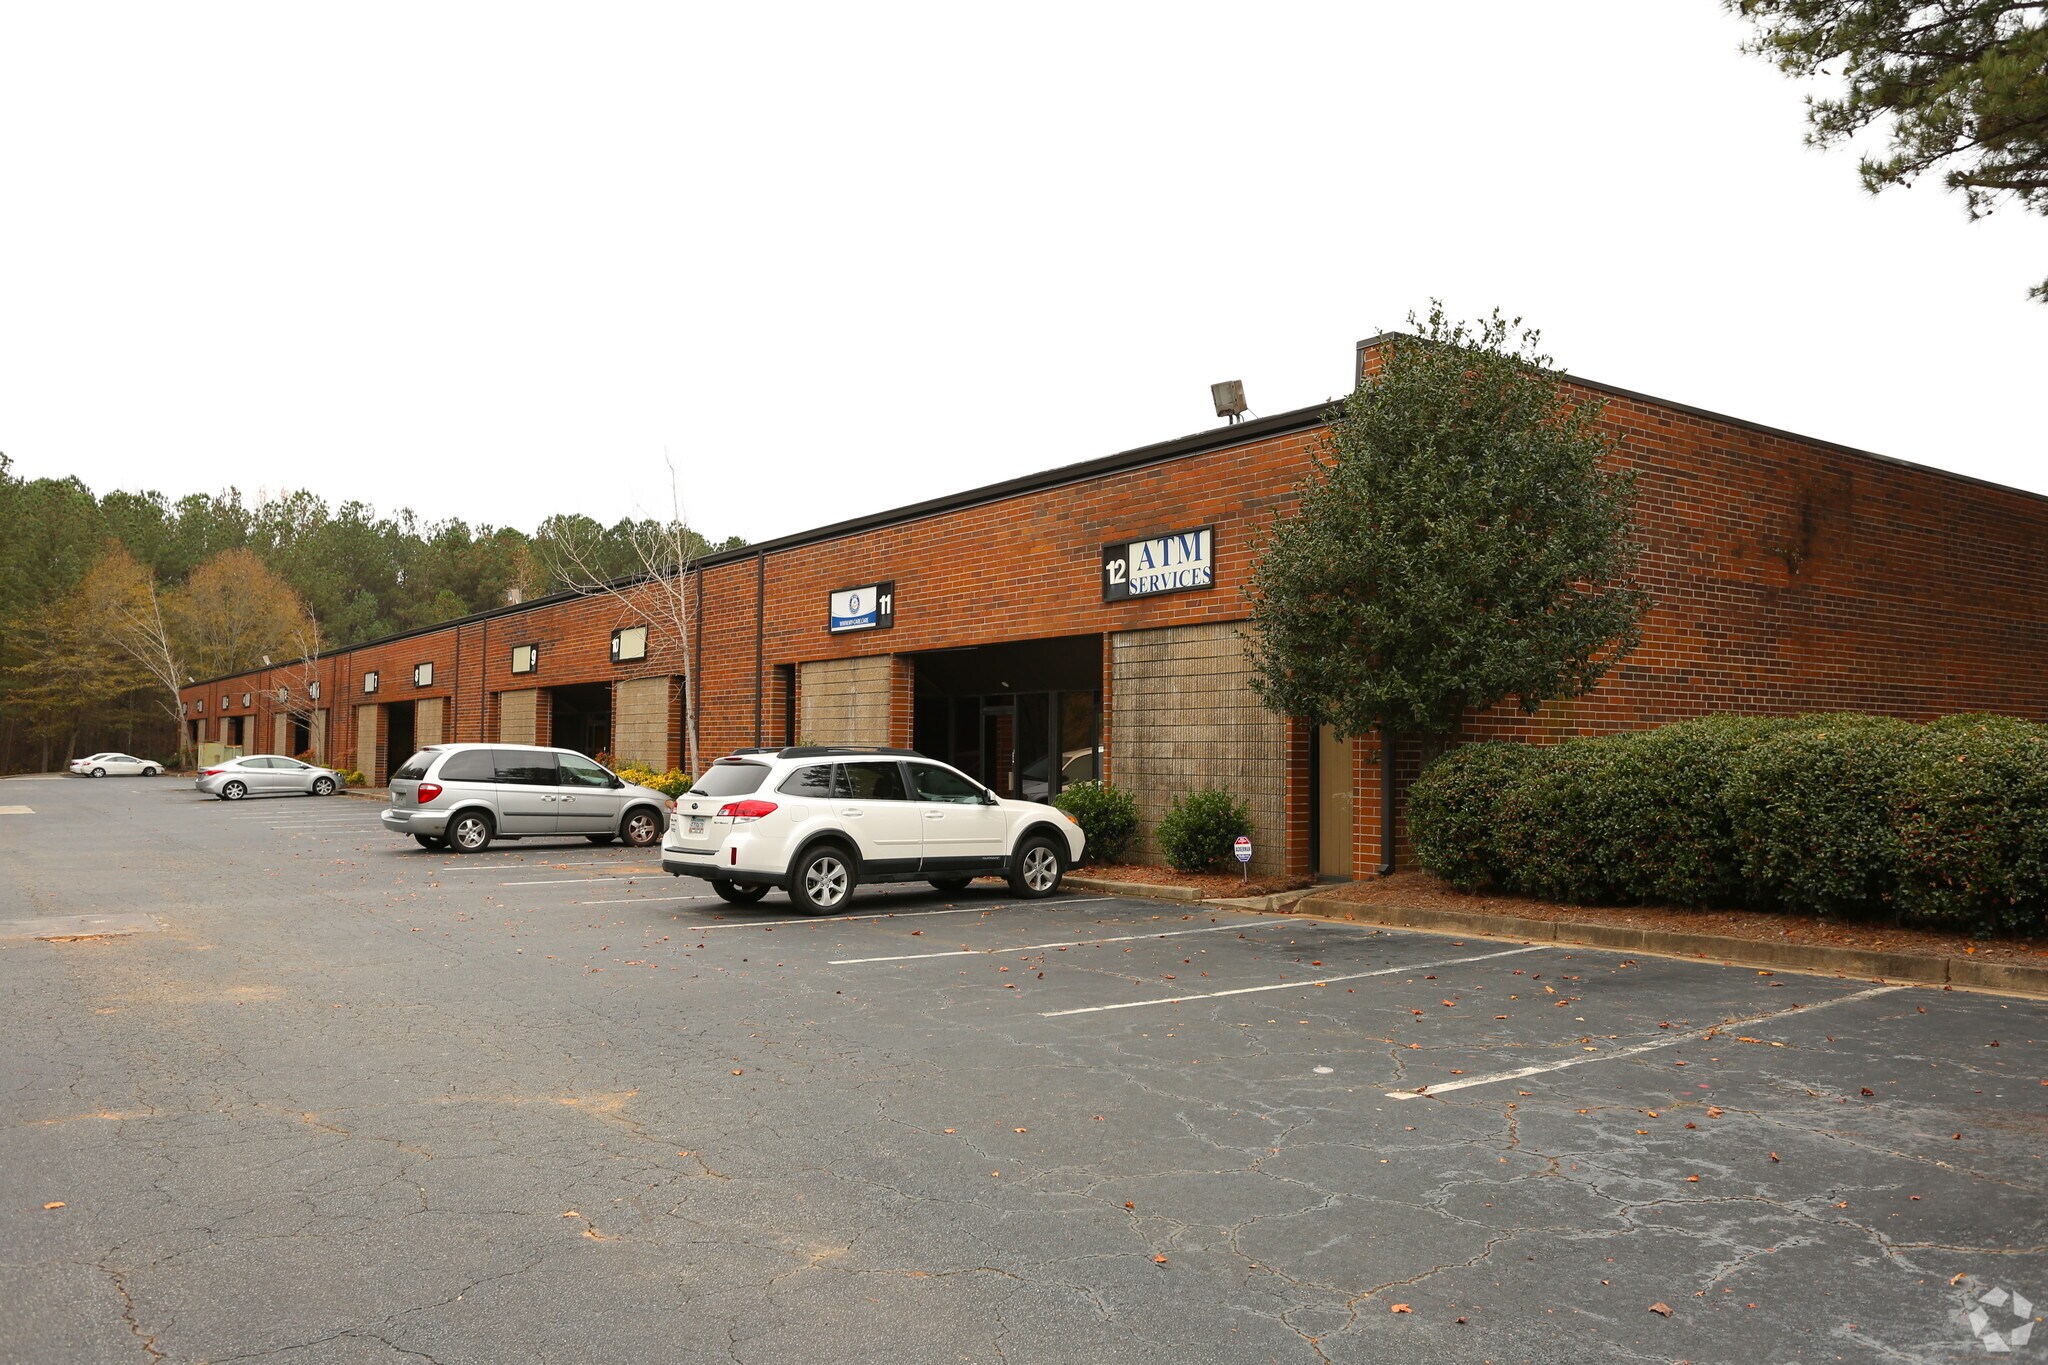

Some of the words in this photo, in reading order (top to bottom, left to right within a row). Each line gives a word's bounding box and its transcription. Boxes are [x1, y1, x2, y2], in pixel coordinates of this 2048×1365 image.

[1136, 530, 1203, 571] ATM
[1105, 558, 1126, 585] 12
[1129, 565, 1211, 596] SERVICES
[879, 594, 891, 615] 11
[531, 649, 537, 665] 9
[612, 638, 619, 653] 10
